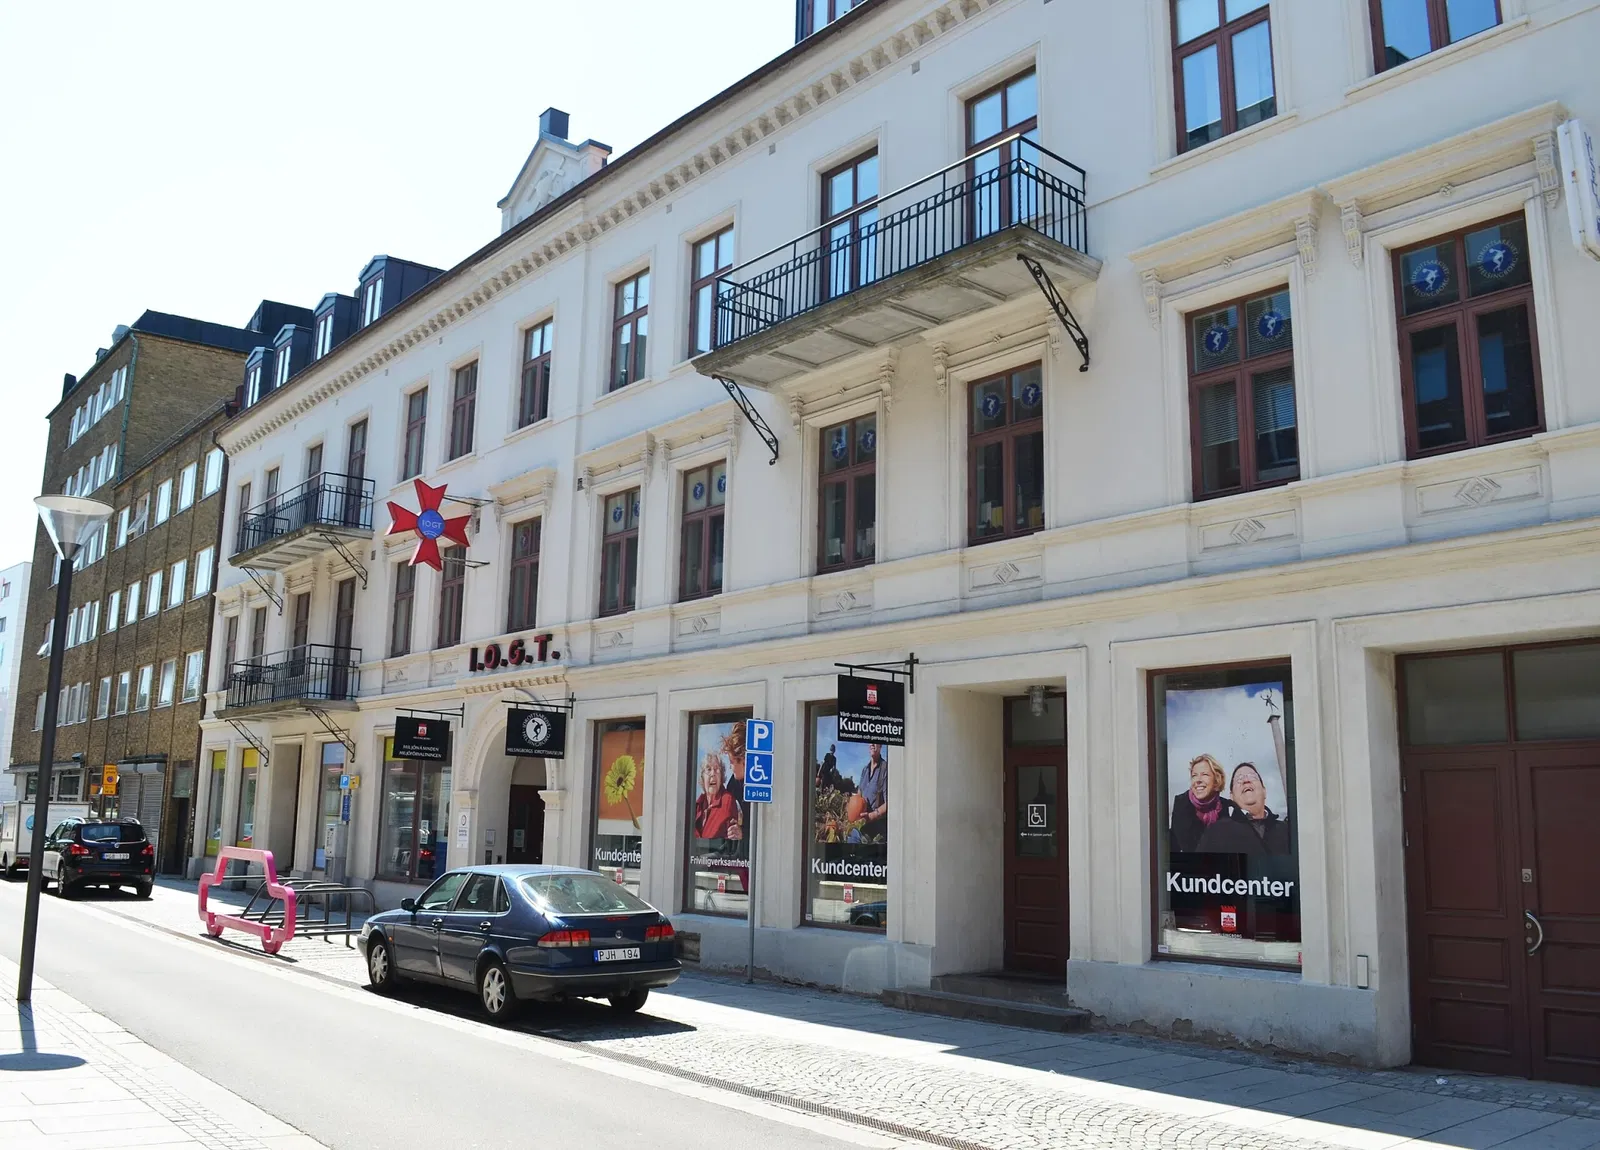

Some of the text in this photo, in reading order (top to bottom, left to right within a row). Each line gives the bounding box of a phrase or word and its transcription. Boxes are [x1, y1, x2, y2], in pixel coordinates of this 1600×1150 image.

[422, 519, 442, 529] IOGT
[840, 717, 903, 736] Kundcenter
[753, 723, 769, 749] P
[342, 776, 348, 784] P
[751, 790, 769, 798] plats
[811, 857, 887, 878] Kundcenter
[1166, 871, 1294, 898] Kundcenter
[599, 949, 639, 960] PJH 194
